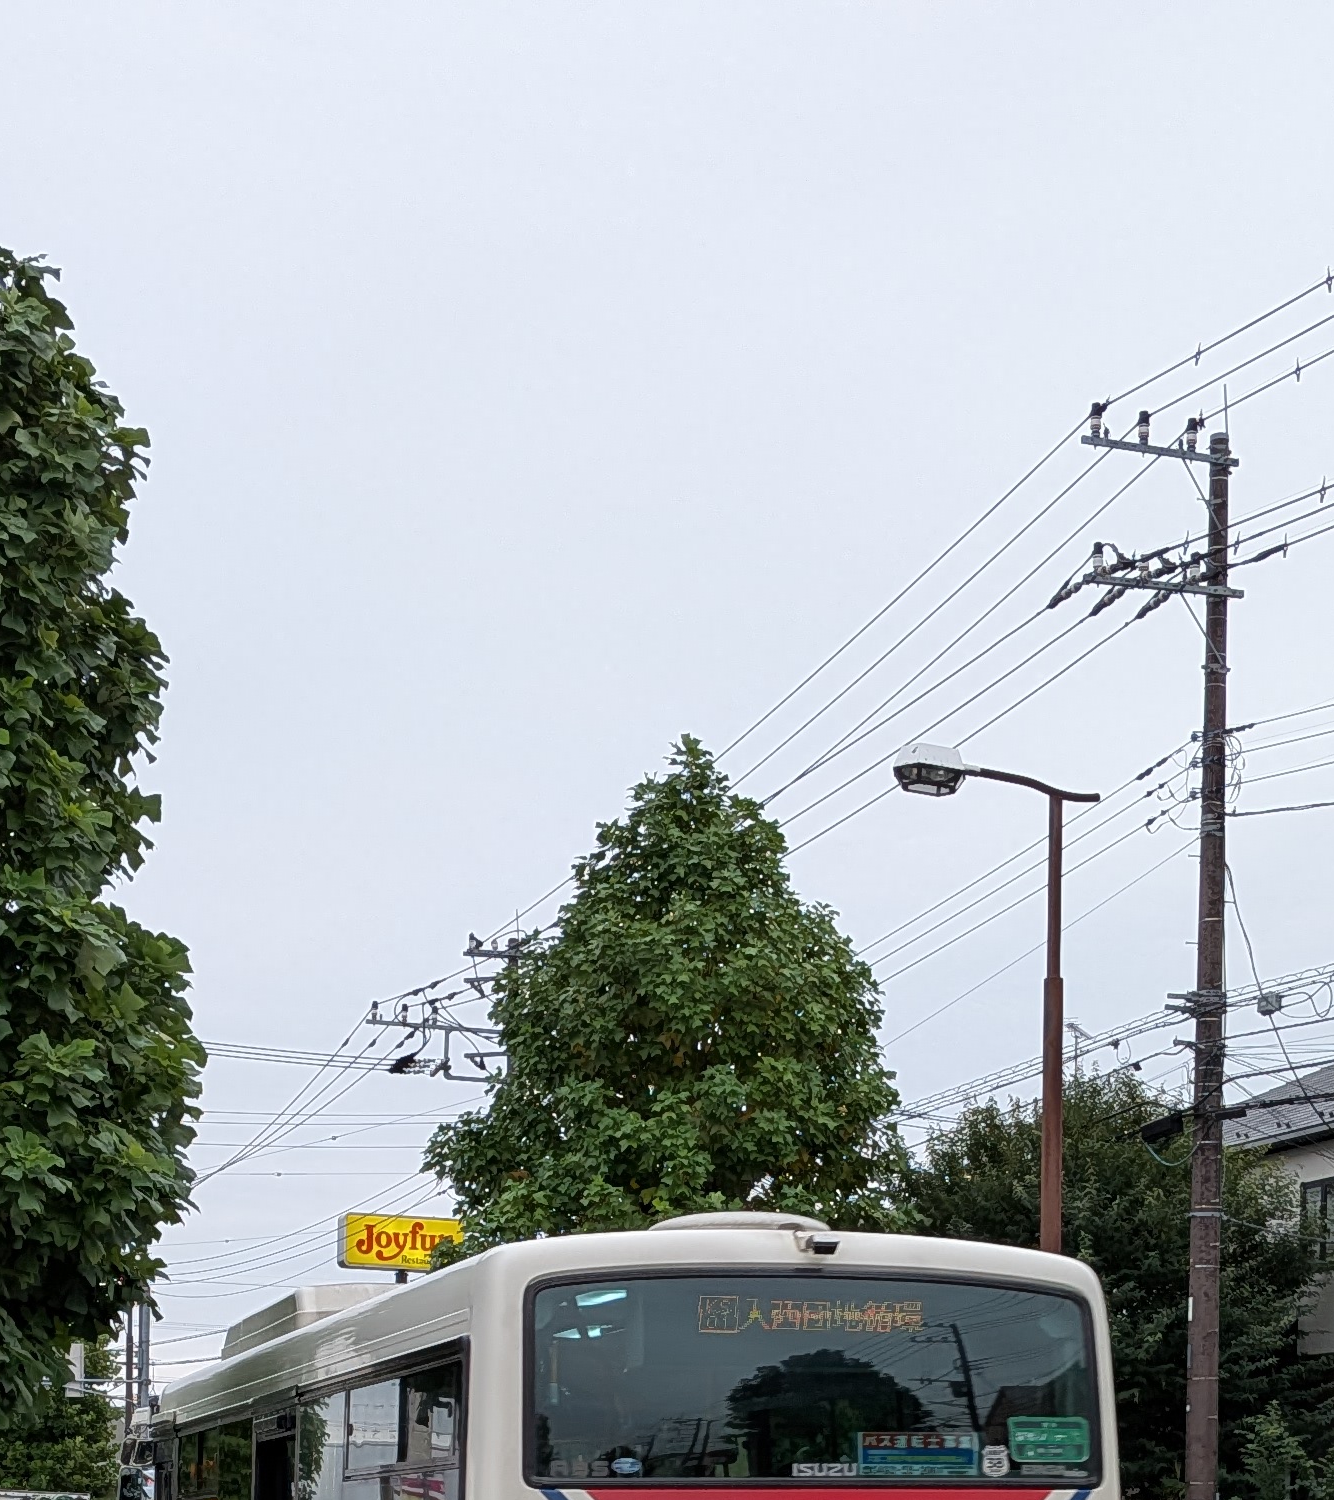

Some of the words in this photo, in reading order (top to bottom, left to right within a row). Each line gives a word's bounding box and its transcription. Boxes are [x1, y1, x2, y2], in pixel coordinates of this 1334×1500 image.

[355, 1221, 453, 1262] Joyfu
[401, 1254, 431, 1266] Restau
[792, 1462, 858, 1477] ISUZU
